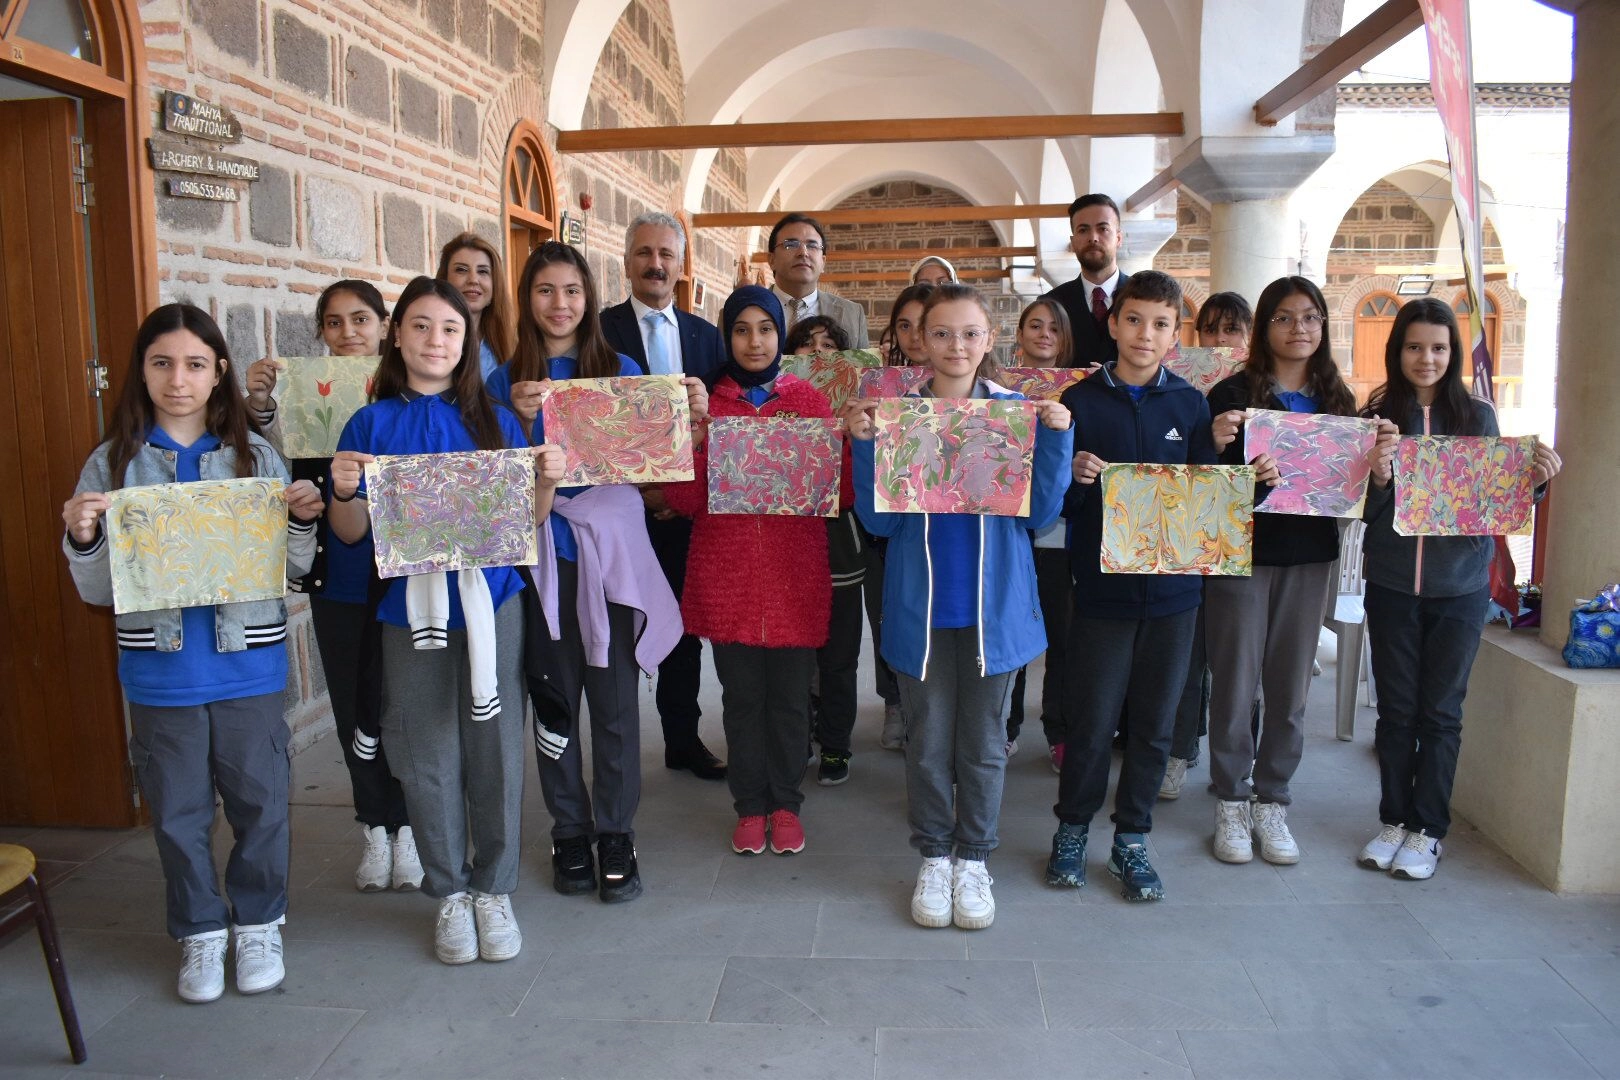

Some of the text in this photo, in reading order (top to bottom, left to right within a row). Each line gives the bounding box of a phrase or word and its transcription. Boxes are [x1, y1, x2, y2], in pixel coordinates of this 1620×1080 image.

[191, 101, 222, 122] MAHYA
[173, 112, 234, 138] TRADITIONAL
[161, 151, 259, 178] ARCHERY & HANDMADE
